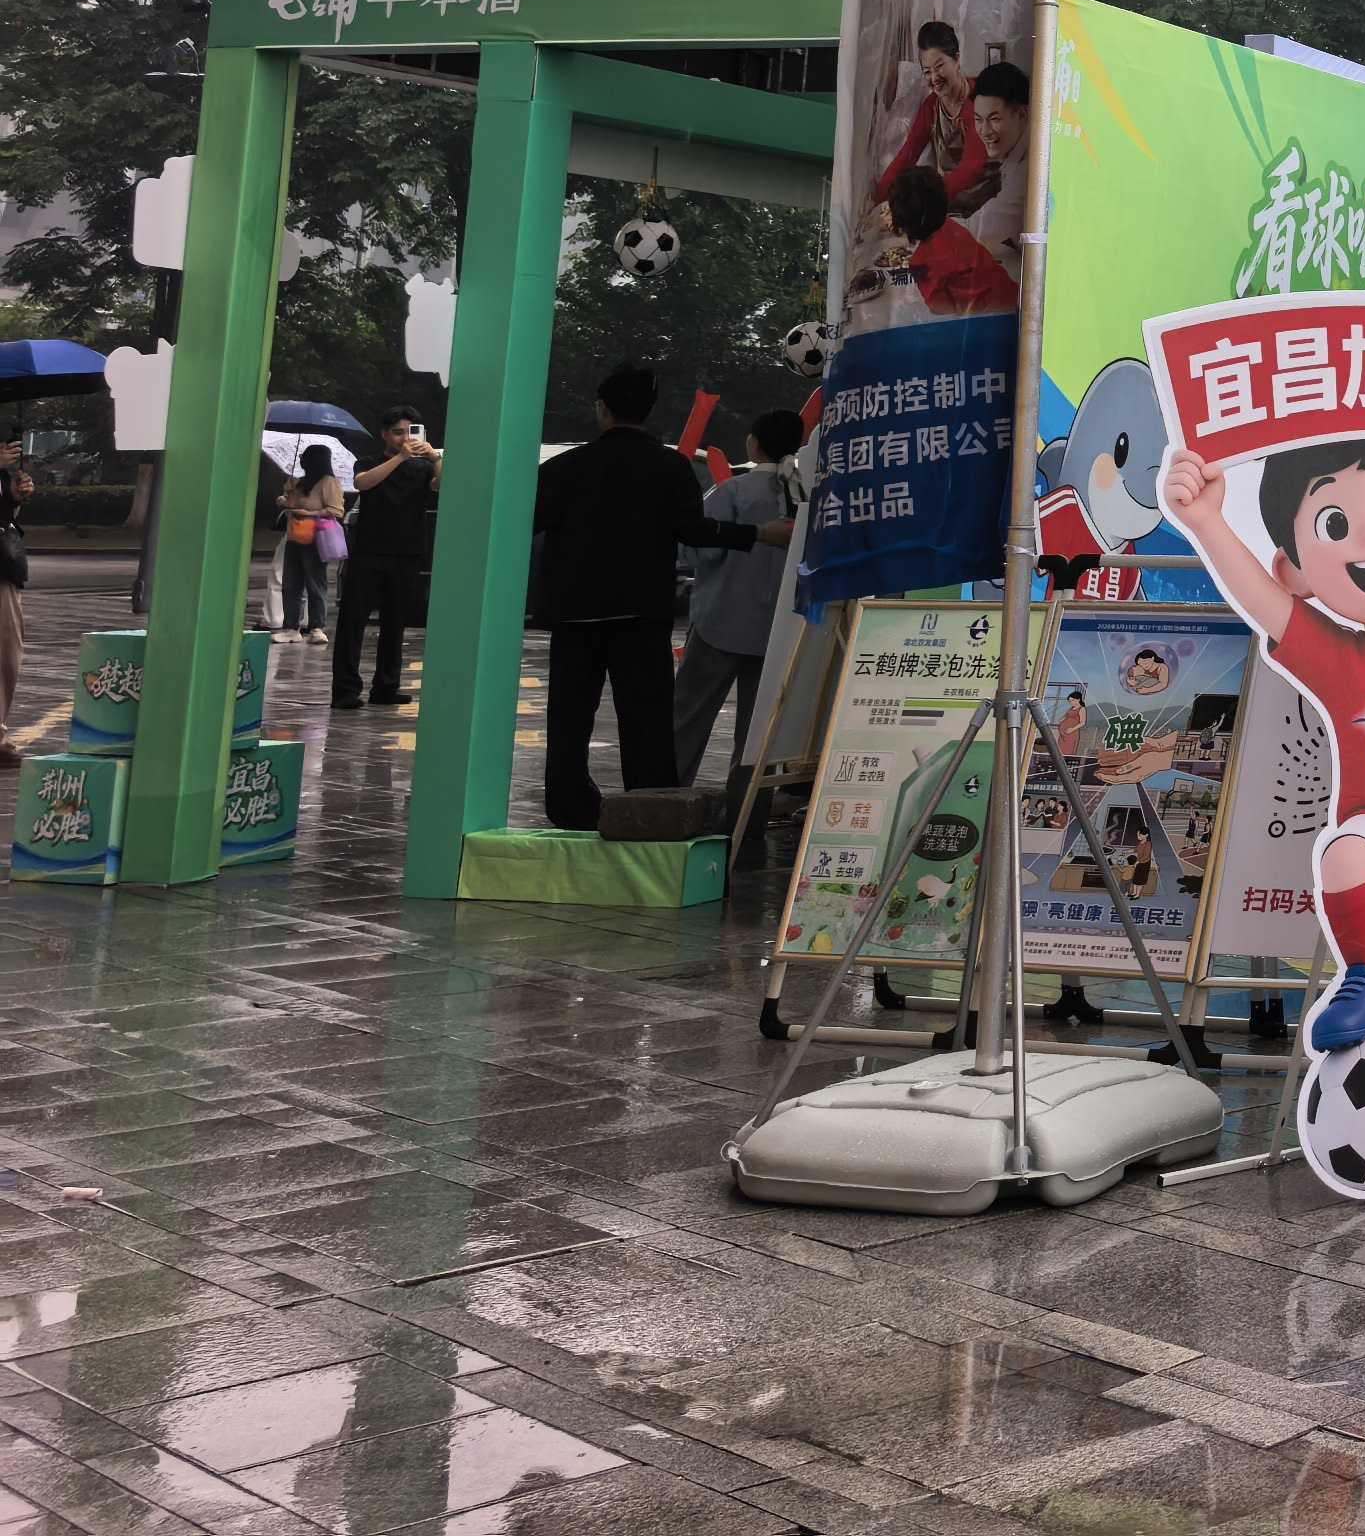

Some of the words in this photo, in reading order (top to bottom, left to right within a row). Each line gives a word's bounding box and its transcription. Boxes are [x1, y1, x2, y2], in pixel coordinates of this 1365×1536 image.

[817, 416, 1012, 483] 集团有限公司
[853, 652, 1033, 681] 云鹤牌浸泡洗涤
[1102, 712, 1149, 753] 碘
[37, 768, 87, 804] 荆州
[31, 811, 89, 847] 必胜
